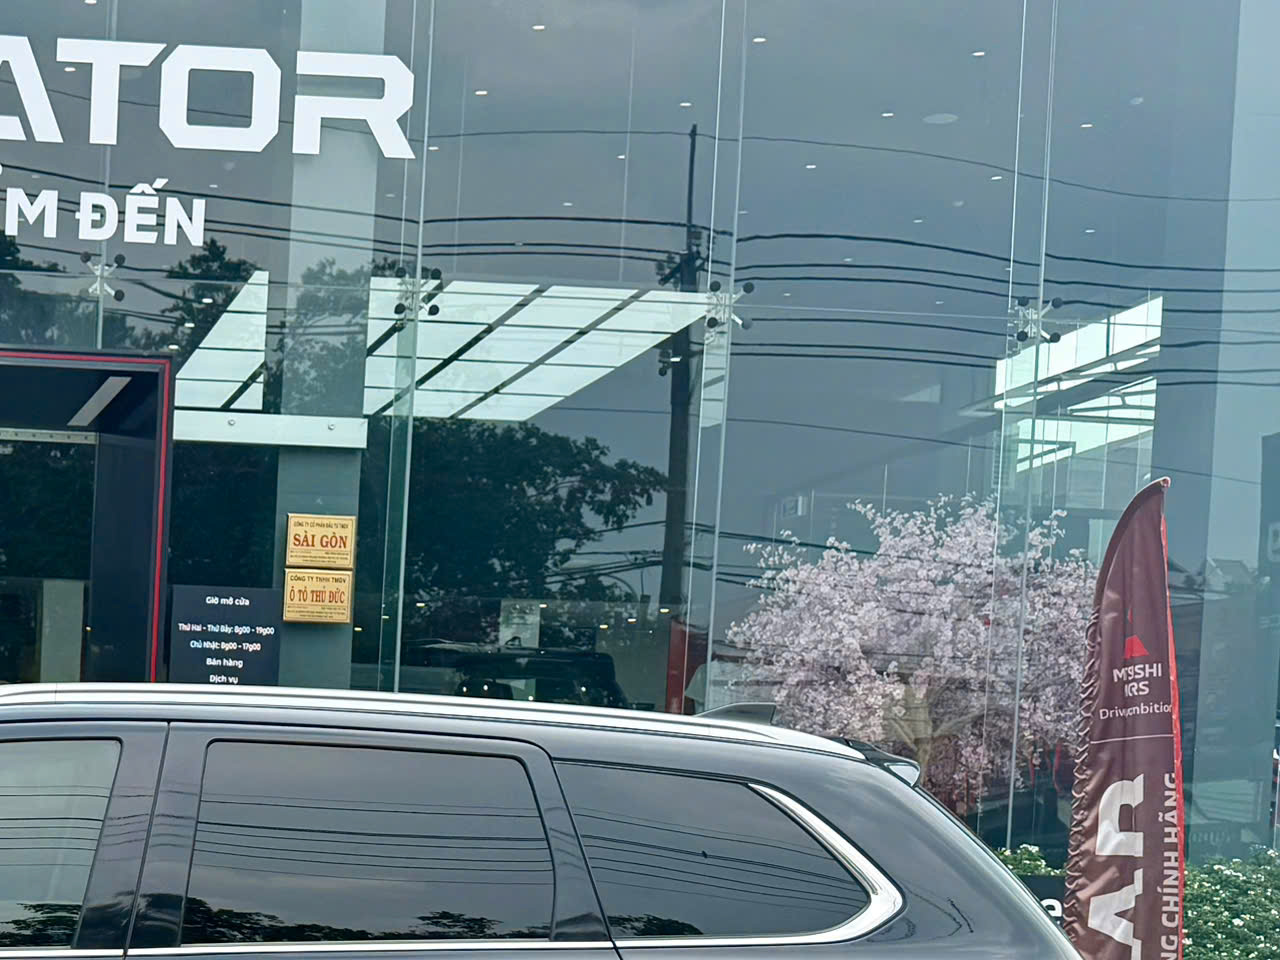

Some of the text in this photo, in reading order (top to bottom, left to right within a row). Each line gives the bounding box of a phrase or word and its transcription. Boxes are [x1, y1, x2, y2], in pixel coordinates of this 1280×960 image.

[75, 178, 206, 246] ĐẾN
[293, 530, 348, 549] SÀI GÒN
[205, 596, 250, 606] Giờ mở cửa
[289, 585, 296, 602] Ô
[298, 586, 308, 602] TÔ
[328, 587, 346, 604] ĐỨC
[191, 624, 202, 632] Hai
[206, 657, 243, 668] Bán hàng
[209, 674, 227, 683] Dịch
[1157, 851, 1180, 928] CHÍNH
